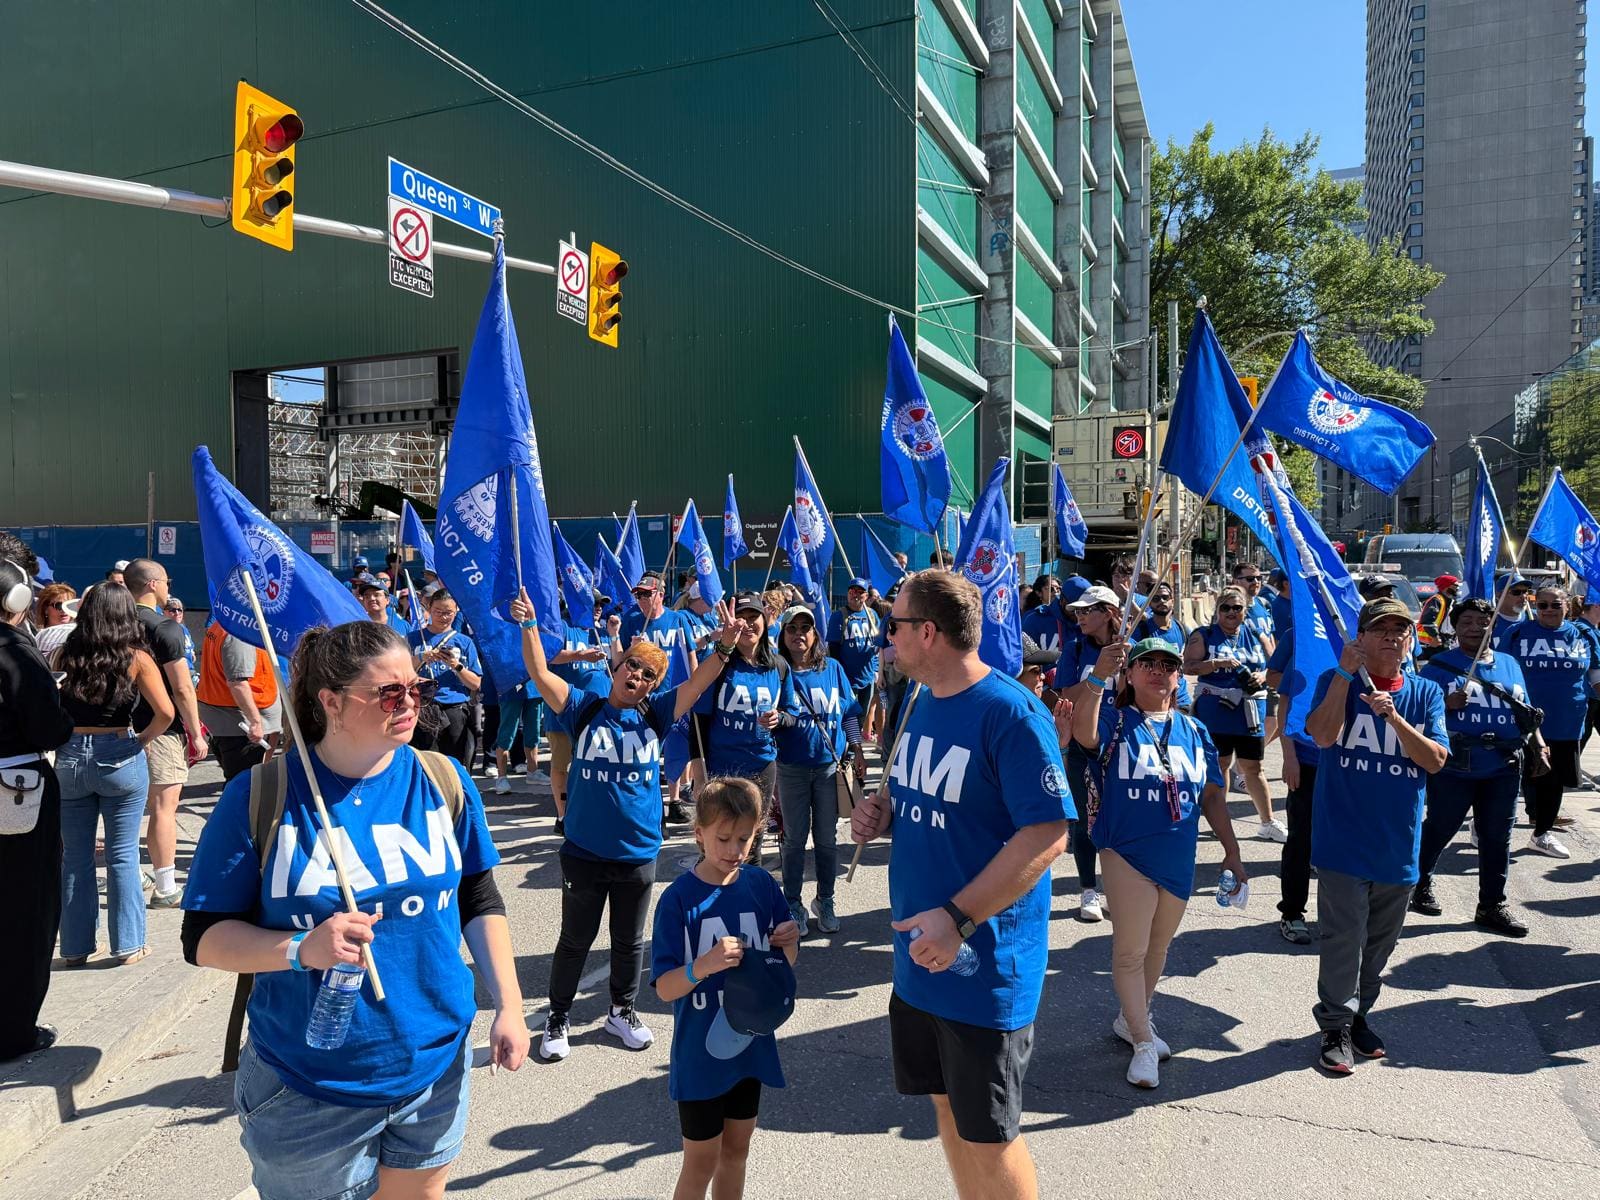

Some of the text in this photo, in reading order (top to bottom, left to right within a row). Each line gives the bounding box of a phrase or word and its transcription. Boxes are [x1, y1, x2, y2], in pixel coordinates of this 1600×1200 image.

[402, 170, 491, 228] Queen St W
[391, 257, 432, 282] TTC VEHICLES
[393, 271, 431, 292] EXCEPTED
[559, 302, 585, 320] EXCEPTED
[1293, 427, 1330, 448] DISTRICT
[1329, 443, 1340, 453] 78
[312, 533, 335, 541] DANGER
[439, 513, 484, 585] RICT 78
[275, 627, 289, 642] 78
[1519, 638, 1587, 658] IAM
[1526, 660, 1585, 669] UNION
[723, 717, 754, 731] UNI
[576, 724, 660, 764] IAM
[582, 767, 653, 783] UNION
[886, 731, 971, 804] AM
[1340, 756, 1418, 778] UNION
[891, 796, 945, 830] NION
[271, 805, 463, 898] IAM
[291, 888, 454, 930] UION
